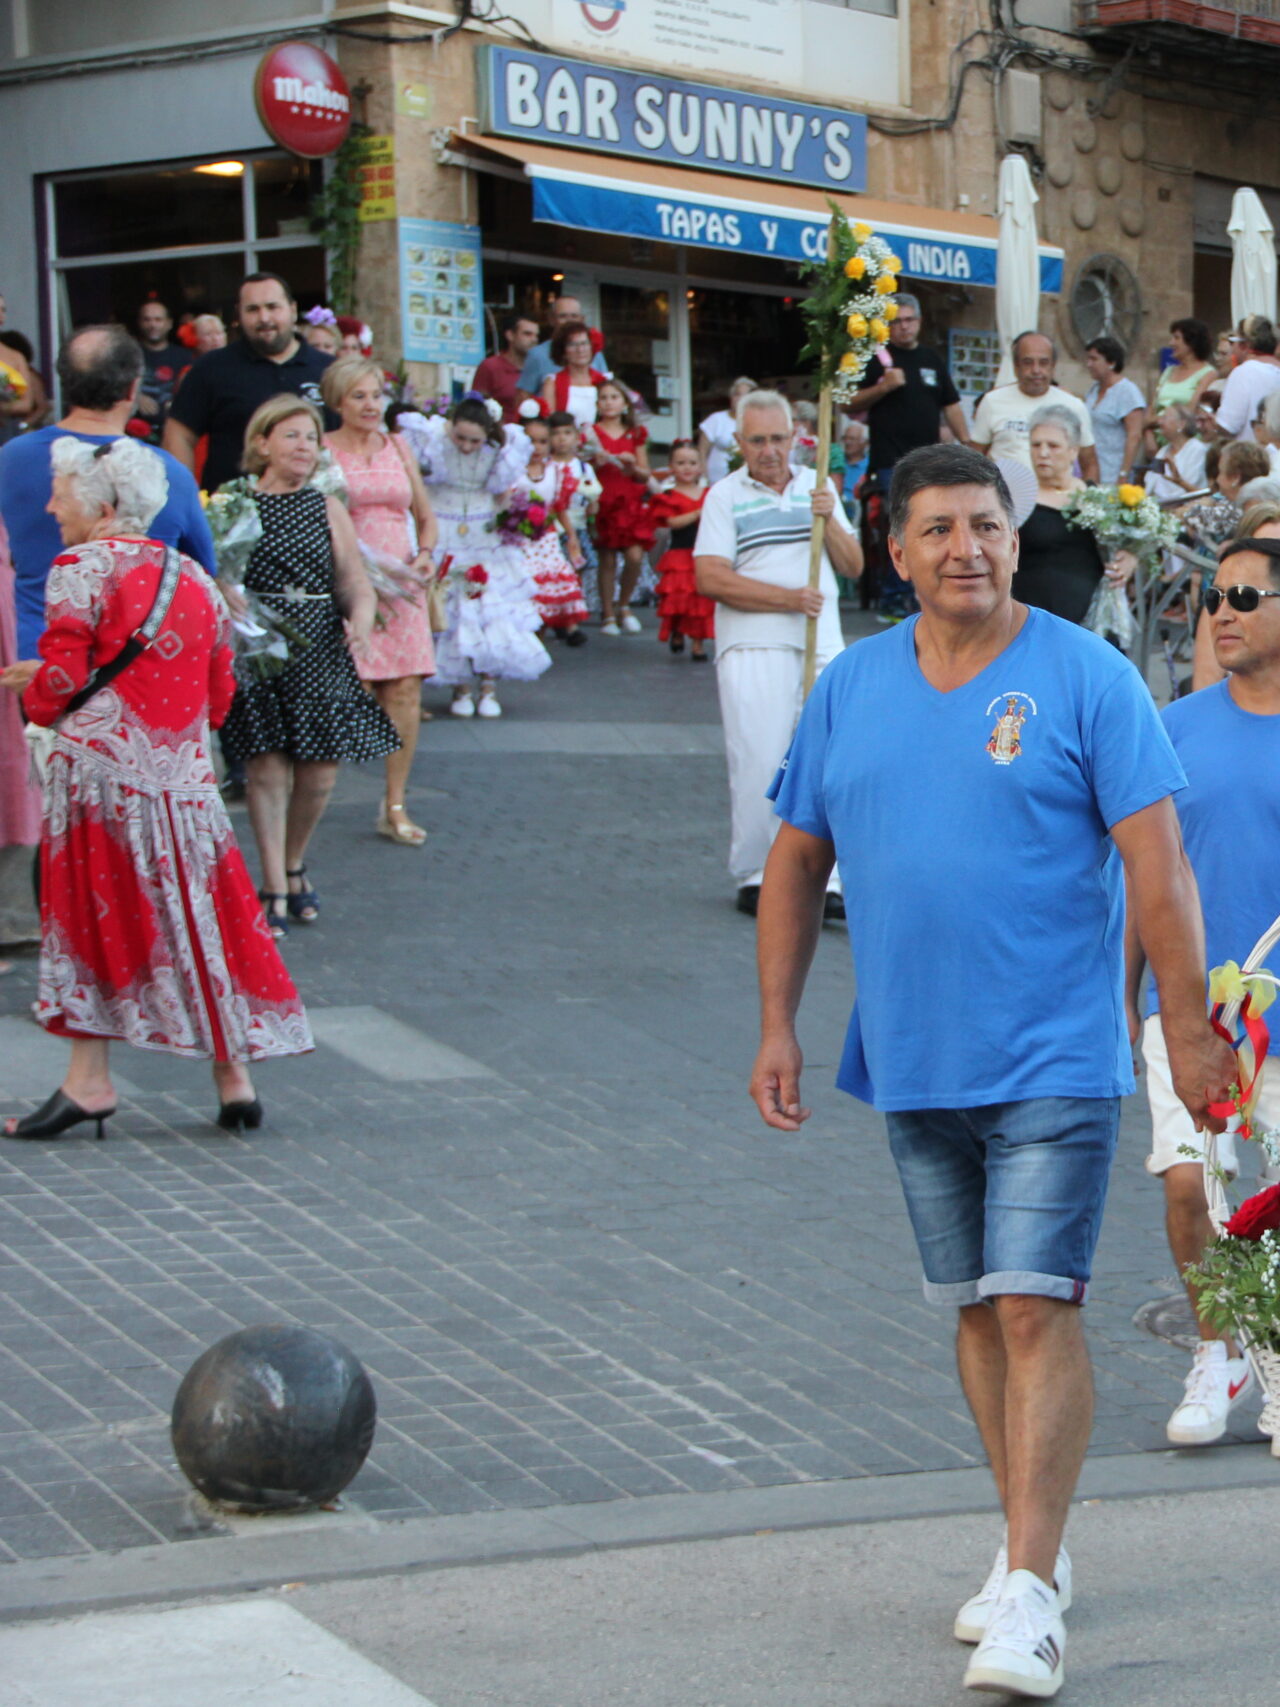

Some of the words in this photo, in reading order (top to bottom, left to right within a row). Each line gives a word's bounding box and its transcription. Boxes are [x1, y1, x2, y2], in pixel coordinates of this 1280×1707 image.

[506, 61, 621, 143] BAR
[634, 85, 852, 181] SUNNY'S
[656, 203, 742, 246] TAPAS
[760, 220, 779, 251] Y
[907, 242, 971, 279] INDIA
